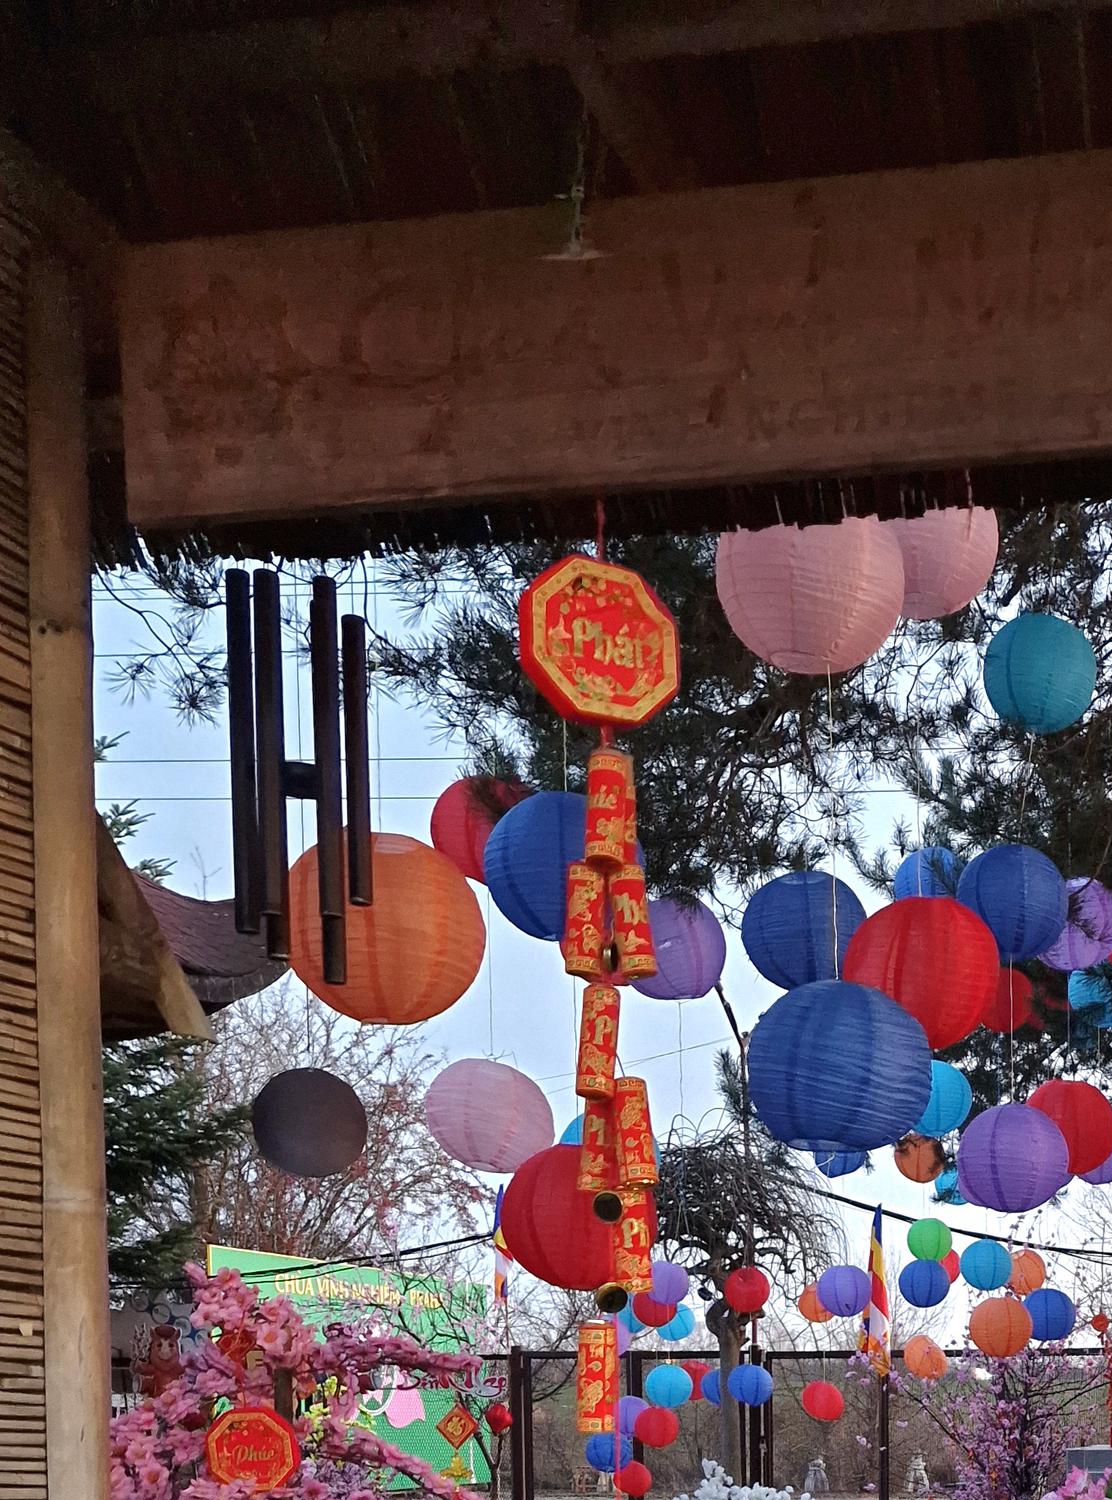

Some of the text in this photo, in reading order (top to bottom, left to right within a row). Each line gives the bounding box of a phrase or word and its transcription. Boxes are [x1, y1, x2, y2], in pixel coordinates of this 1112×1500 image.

[571, 616, 645, 670] Phát
[274, 1270, 315, 1297] CHÙA
[232, 1443, 276, 1466] Phúc
